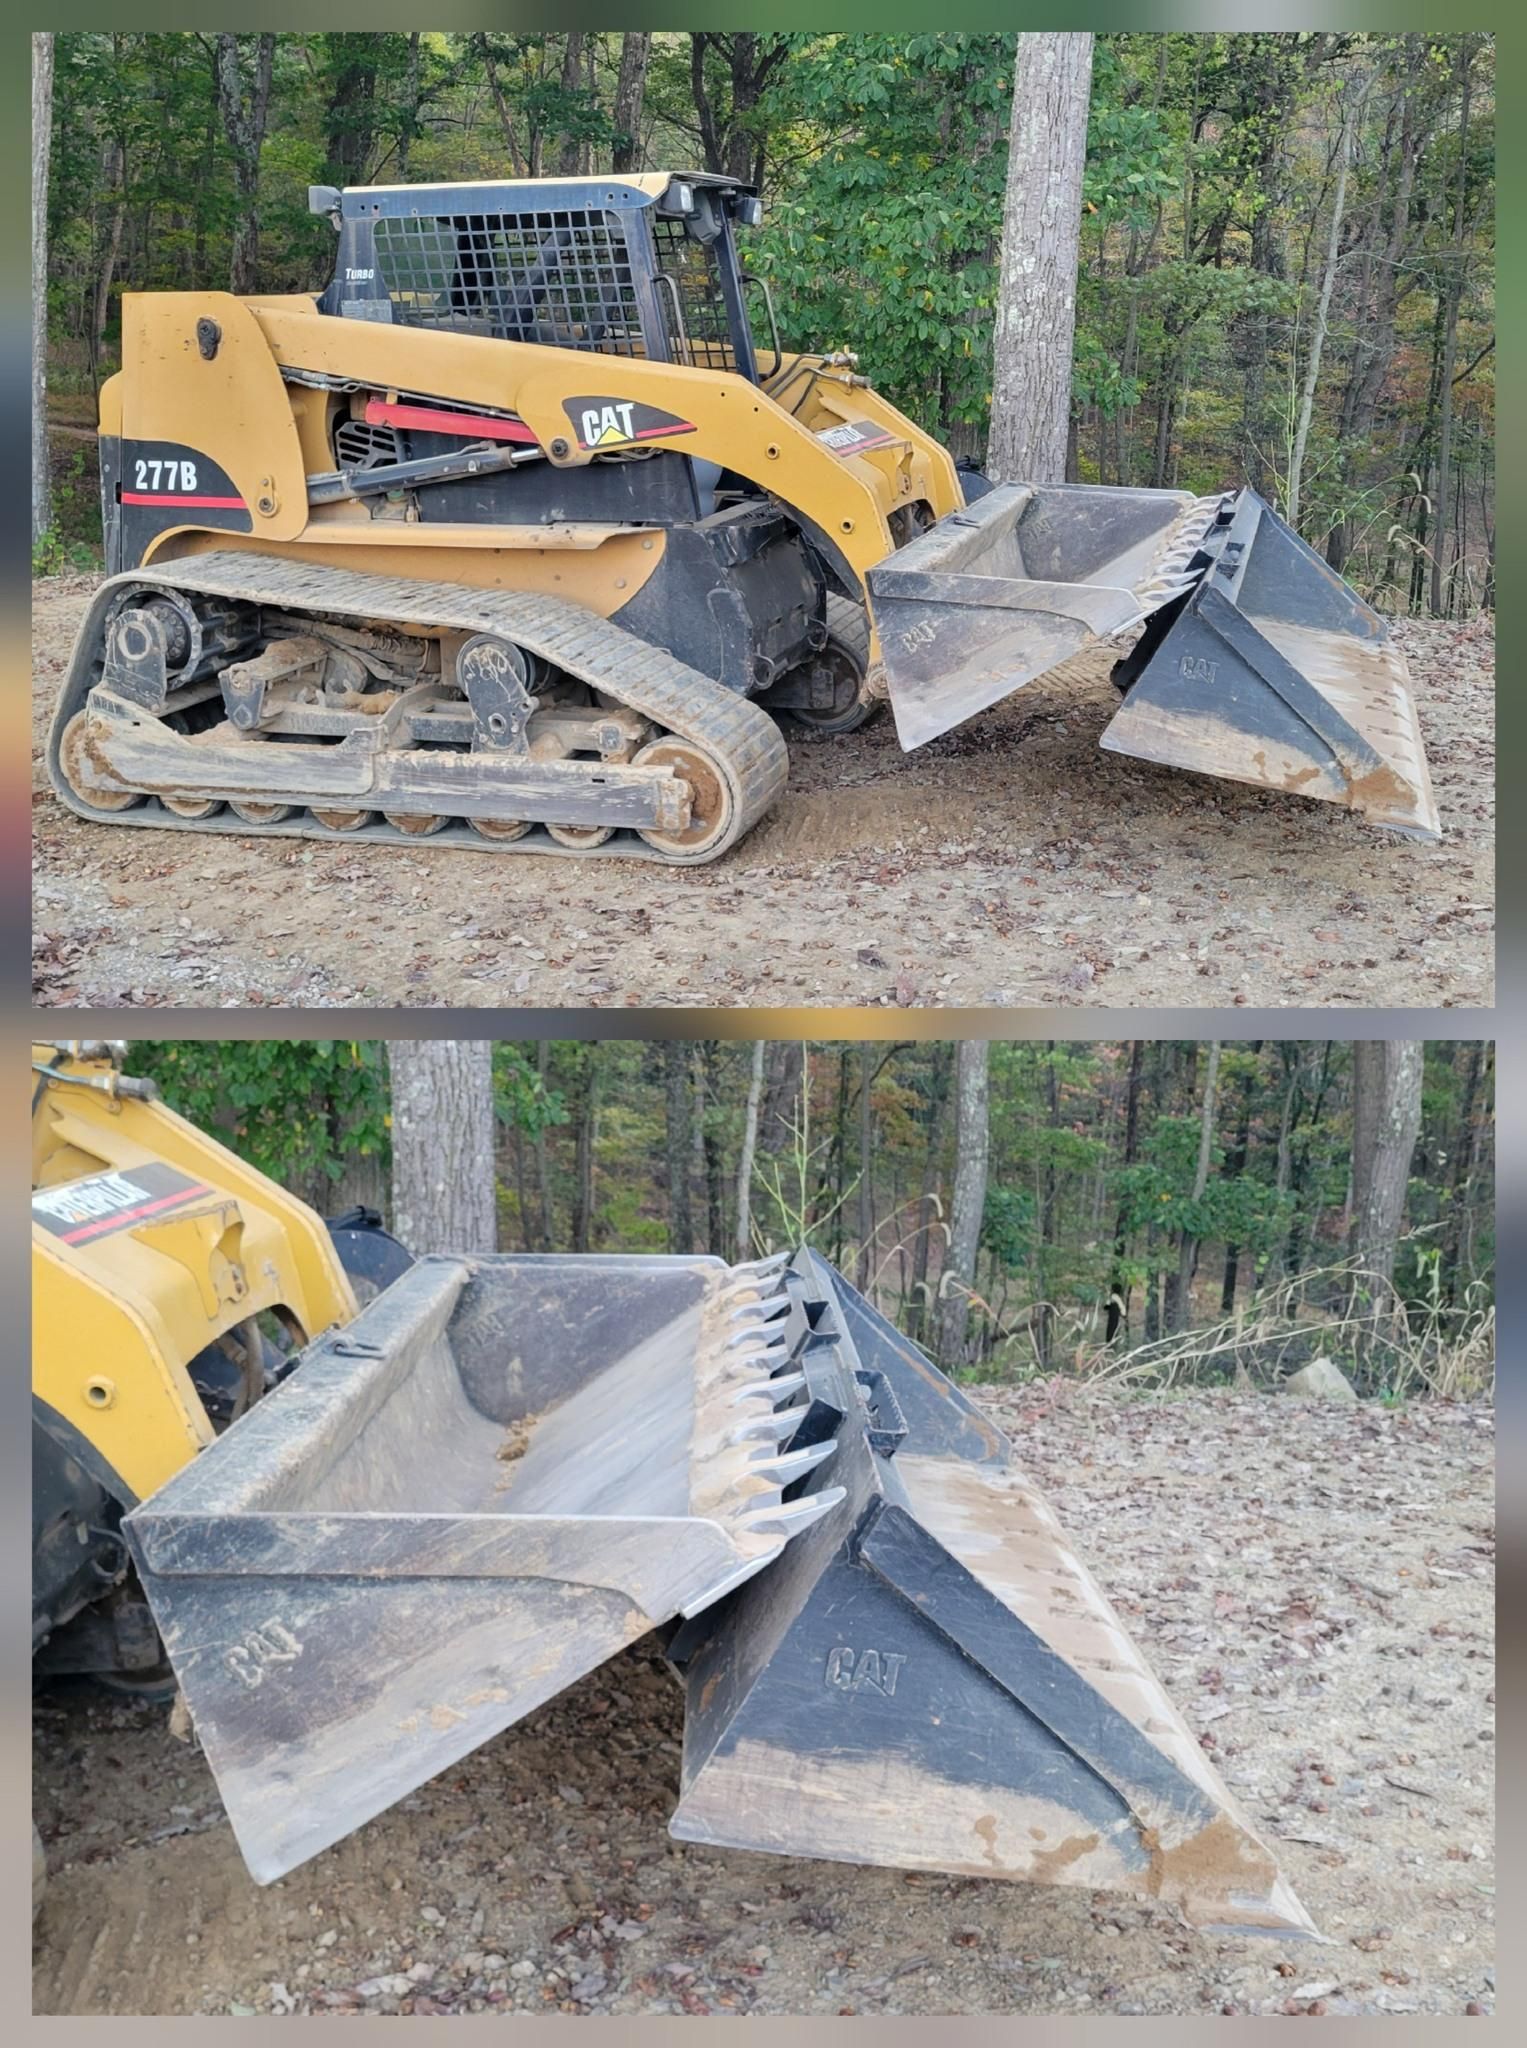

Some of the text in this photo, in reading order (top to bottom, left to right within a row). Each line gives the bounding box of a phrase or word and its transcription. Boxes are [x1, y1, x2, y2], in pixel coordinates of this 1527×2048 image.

[345, 268, 374, 280] TURBO
[581, 402, 635, 446] CAT
[135, 459, 198, 491] 277B
[1179, 656, 1220, 685] CAT
[223, 1615, 304, 1690] CAT
[824, 1647, 907, 1697] CAT
